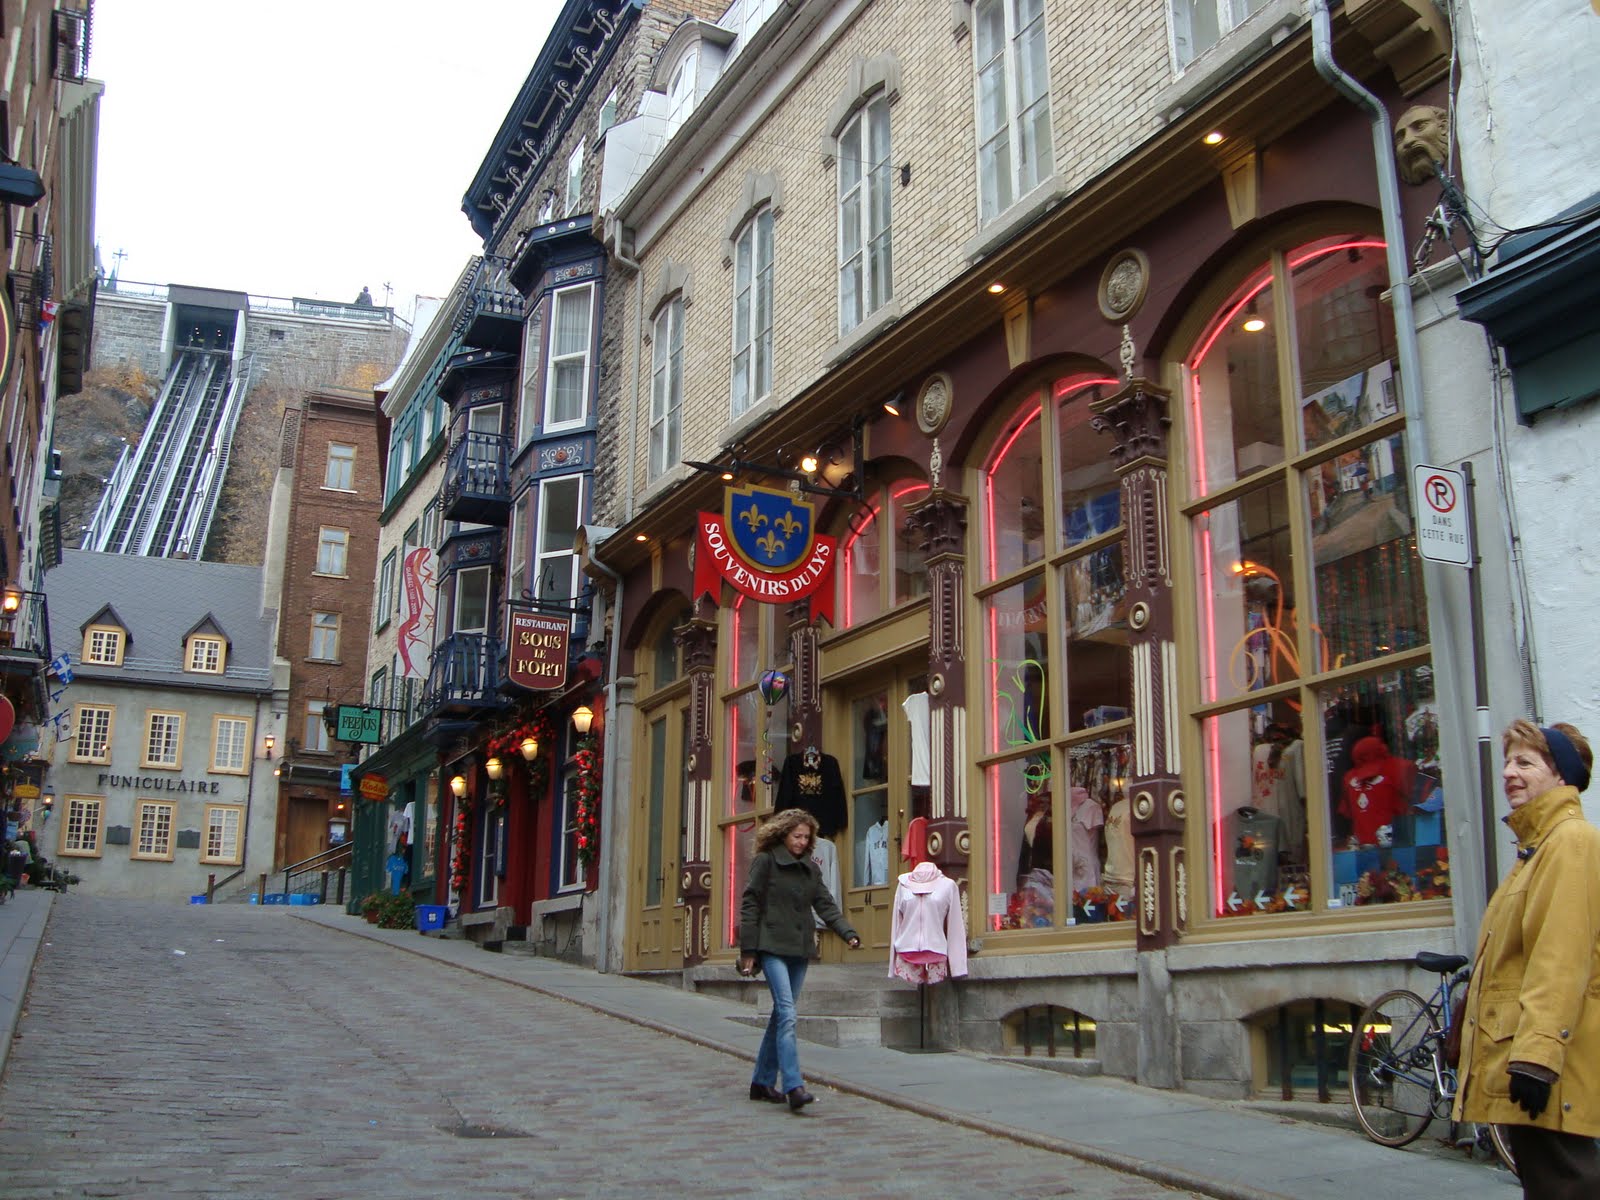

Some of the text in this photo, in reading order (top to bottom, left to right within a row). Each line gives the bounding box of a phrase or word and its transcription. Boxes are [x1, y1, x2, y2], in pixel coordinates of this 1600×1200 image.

[1432, 514, 1452, 528] DANS
[1421, 528, 1465, 545] CETTE RUE
[704, 522, 831, 596] SOUVENIRS DU LYS
[515, 617, 568, 632] RESTAURANT
[519, 631, 562, 650] SOUS
[534, 649, 547, 659] LE
[516, 659, 563, 677] FORT
[98, 774, 220, 794] FUNICULAIRE
